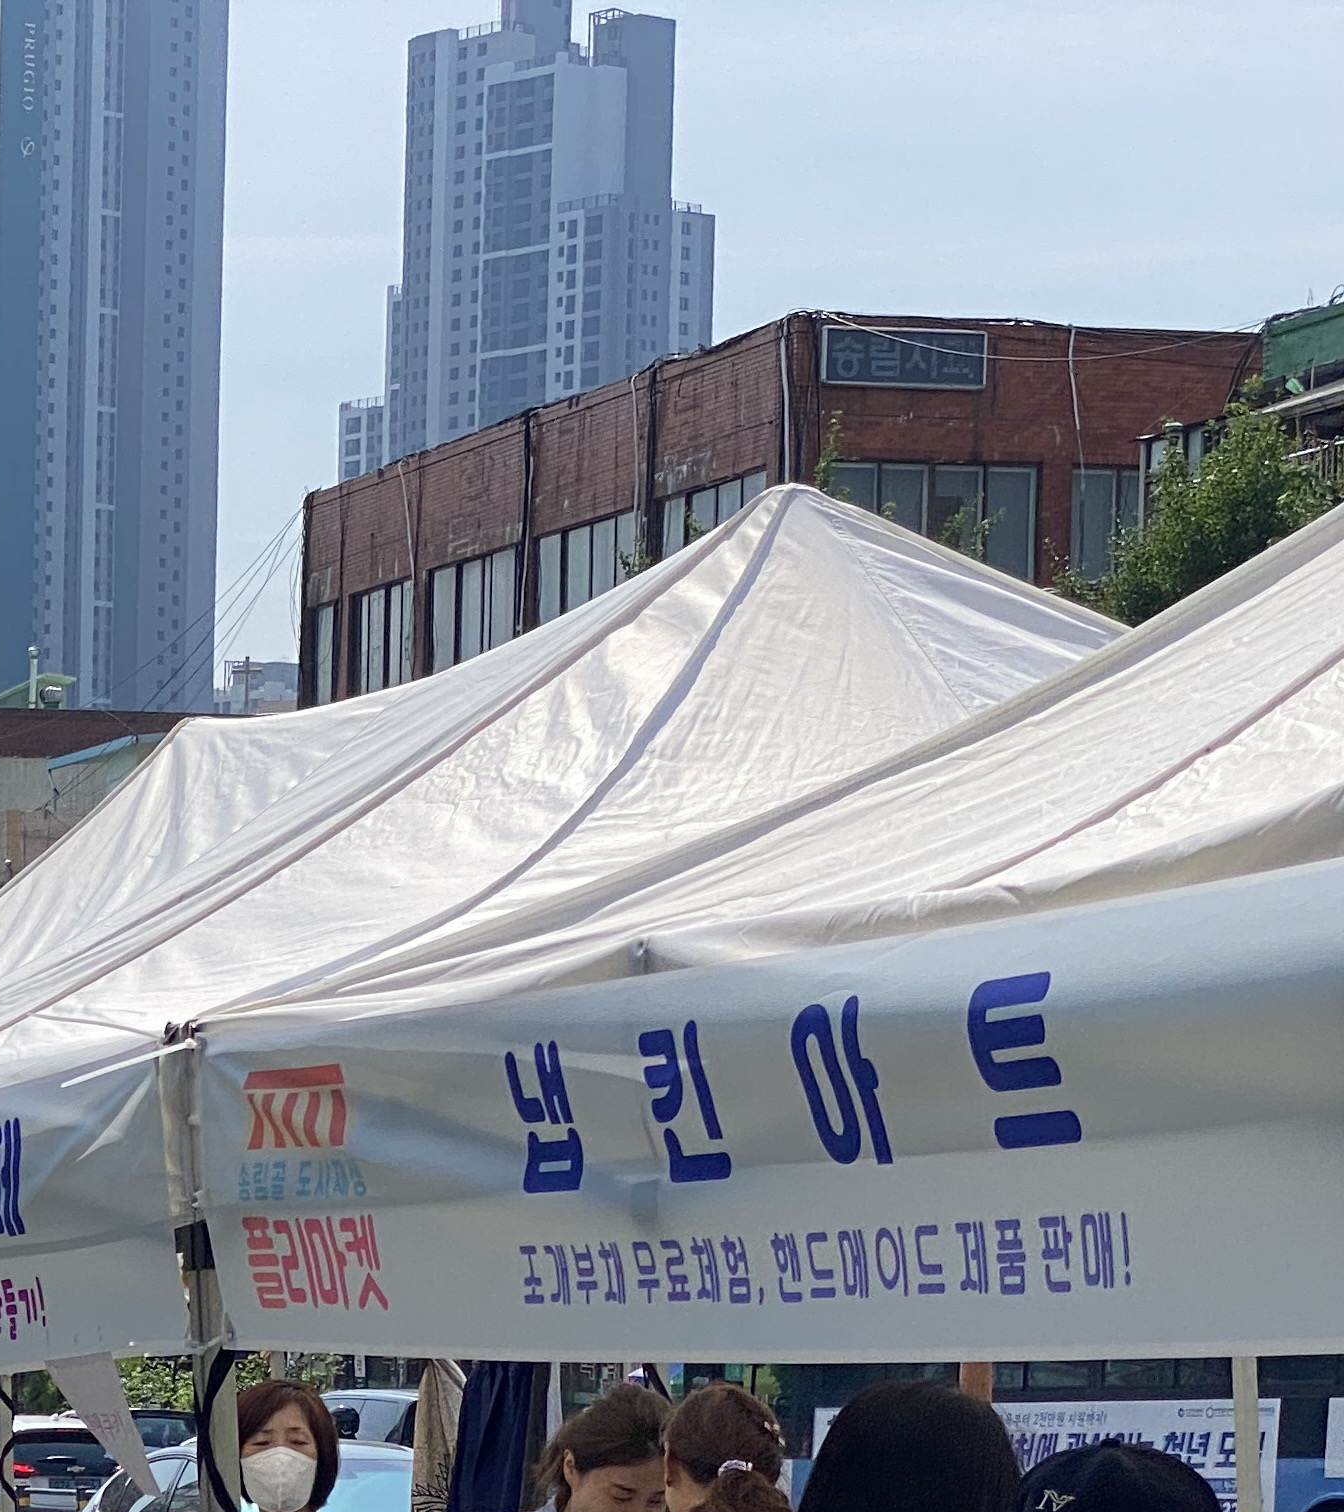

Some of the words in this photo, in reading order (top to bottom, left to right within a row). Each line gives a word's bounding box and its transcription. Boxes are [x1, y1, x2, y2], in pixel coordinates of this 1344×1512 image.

[238, 1160, 287, 1201] 송림골
[296, 1159, 368, 1199] 도시재생
[242, 1213, 390, 1312] 플리마켓
[518, 1240, 627, 1306] 조개부채
[631, 1234, 764, 1306] 무료체험,
[769, 1224, 946, 1303] 핸드메이드
[954, 1218, 1027, 1297] 제품
[1038, 1211, 1132, 1294] 판매!
